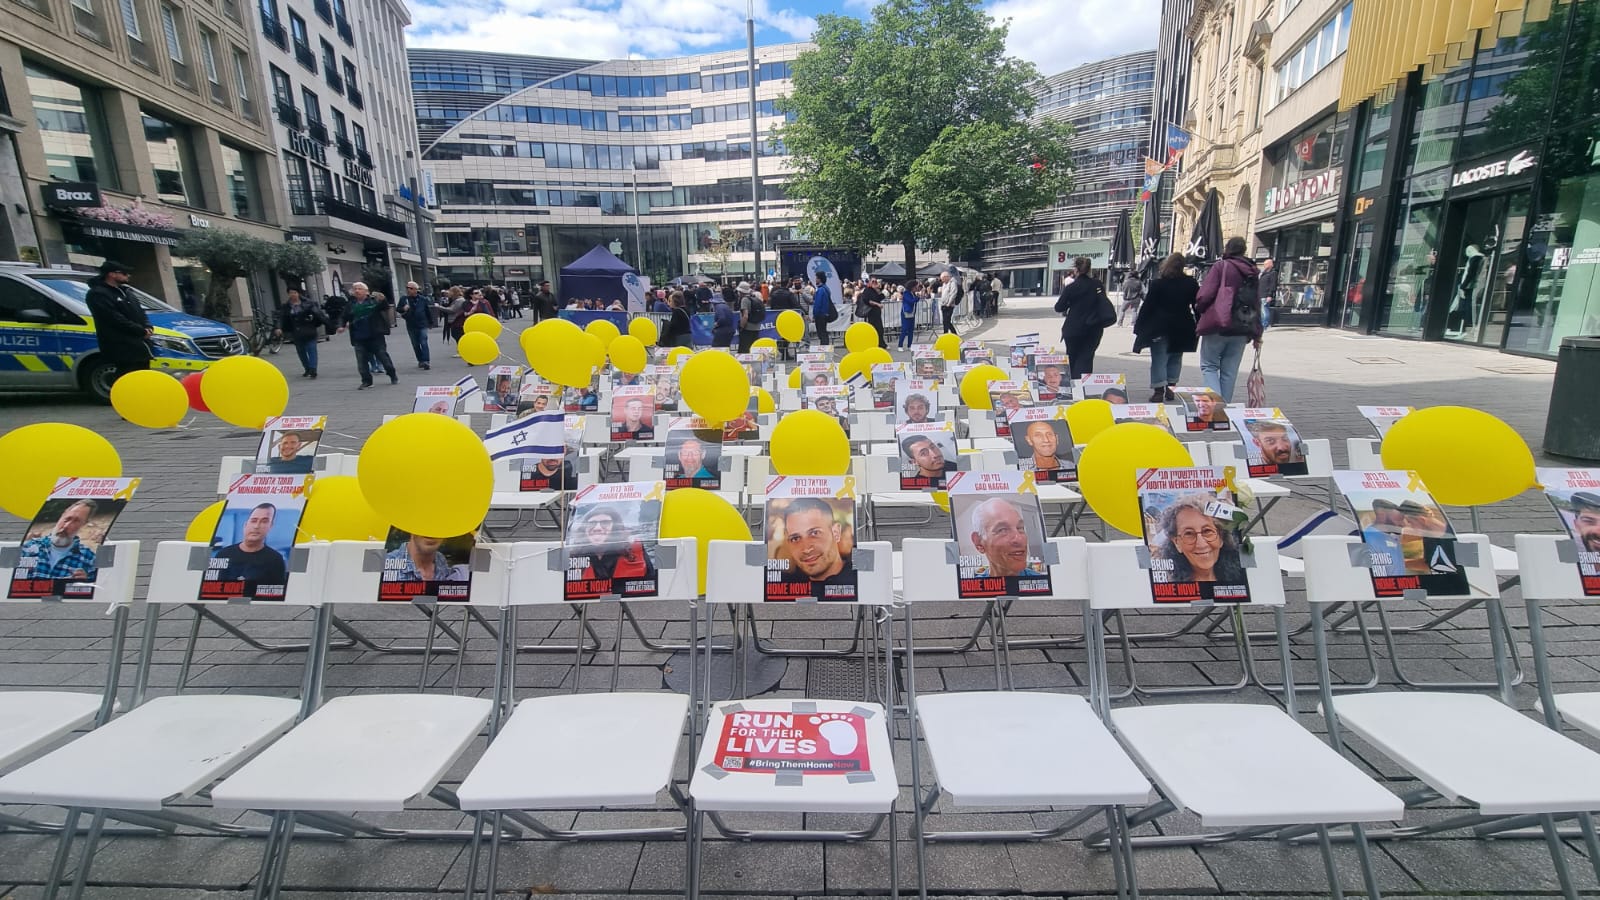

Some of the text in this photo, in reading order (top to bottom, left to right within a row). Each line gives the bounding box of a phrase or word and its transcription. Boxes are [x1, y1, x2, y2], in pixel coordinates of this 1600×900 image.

[1452, 160, 1506, 187] LACOSTE
[55, 188, 93, 201] Brax
[190, 213, 210, 228] Brax
[1146, 480, 1167, 490] JUDITH
[1168, 480, 1201, 489] WEINSTEIN
[384, 558, 407, 570] BRING
[767, 558, 790, 570] BRING
[960, 555, 982, 567] BRING
[1151, 558, 1174, 571] BRING
[204, 569, 219, 581] HIM
[383, 570, 398, 582] HIM
[567, 568, 582, 581] HIM
[767, 570, 781, 582] HIM
[960, 567, 975, 579] HIM
[1152, 571, 1168, 583] HER
[381, 582, 403, 594] HOME
[404, 582, 426, 594] NOW!
[567, 581, 589, 593] HOME
[590, 580, 612, 592] NOW!
[767, 582, 788, 595] HOME
[789, 582, 811, 595] NOW!
[961, 579, 983, 591] HOME
[984, 577, 1006, 591] NOW!
[1154, 583, 1177, 596] HOME
[1178, 581, 1200, 595] NOW!
[732, 713, 794, 728] RUN
[730, 727, 804, 738] FOR THEIR
[726, 737, 817, 754] LIVES
[749, 759, 855, 771] #BringThemHomeNow
